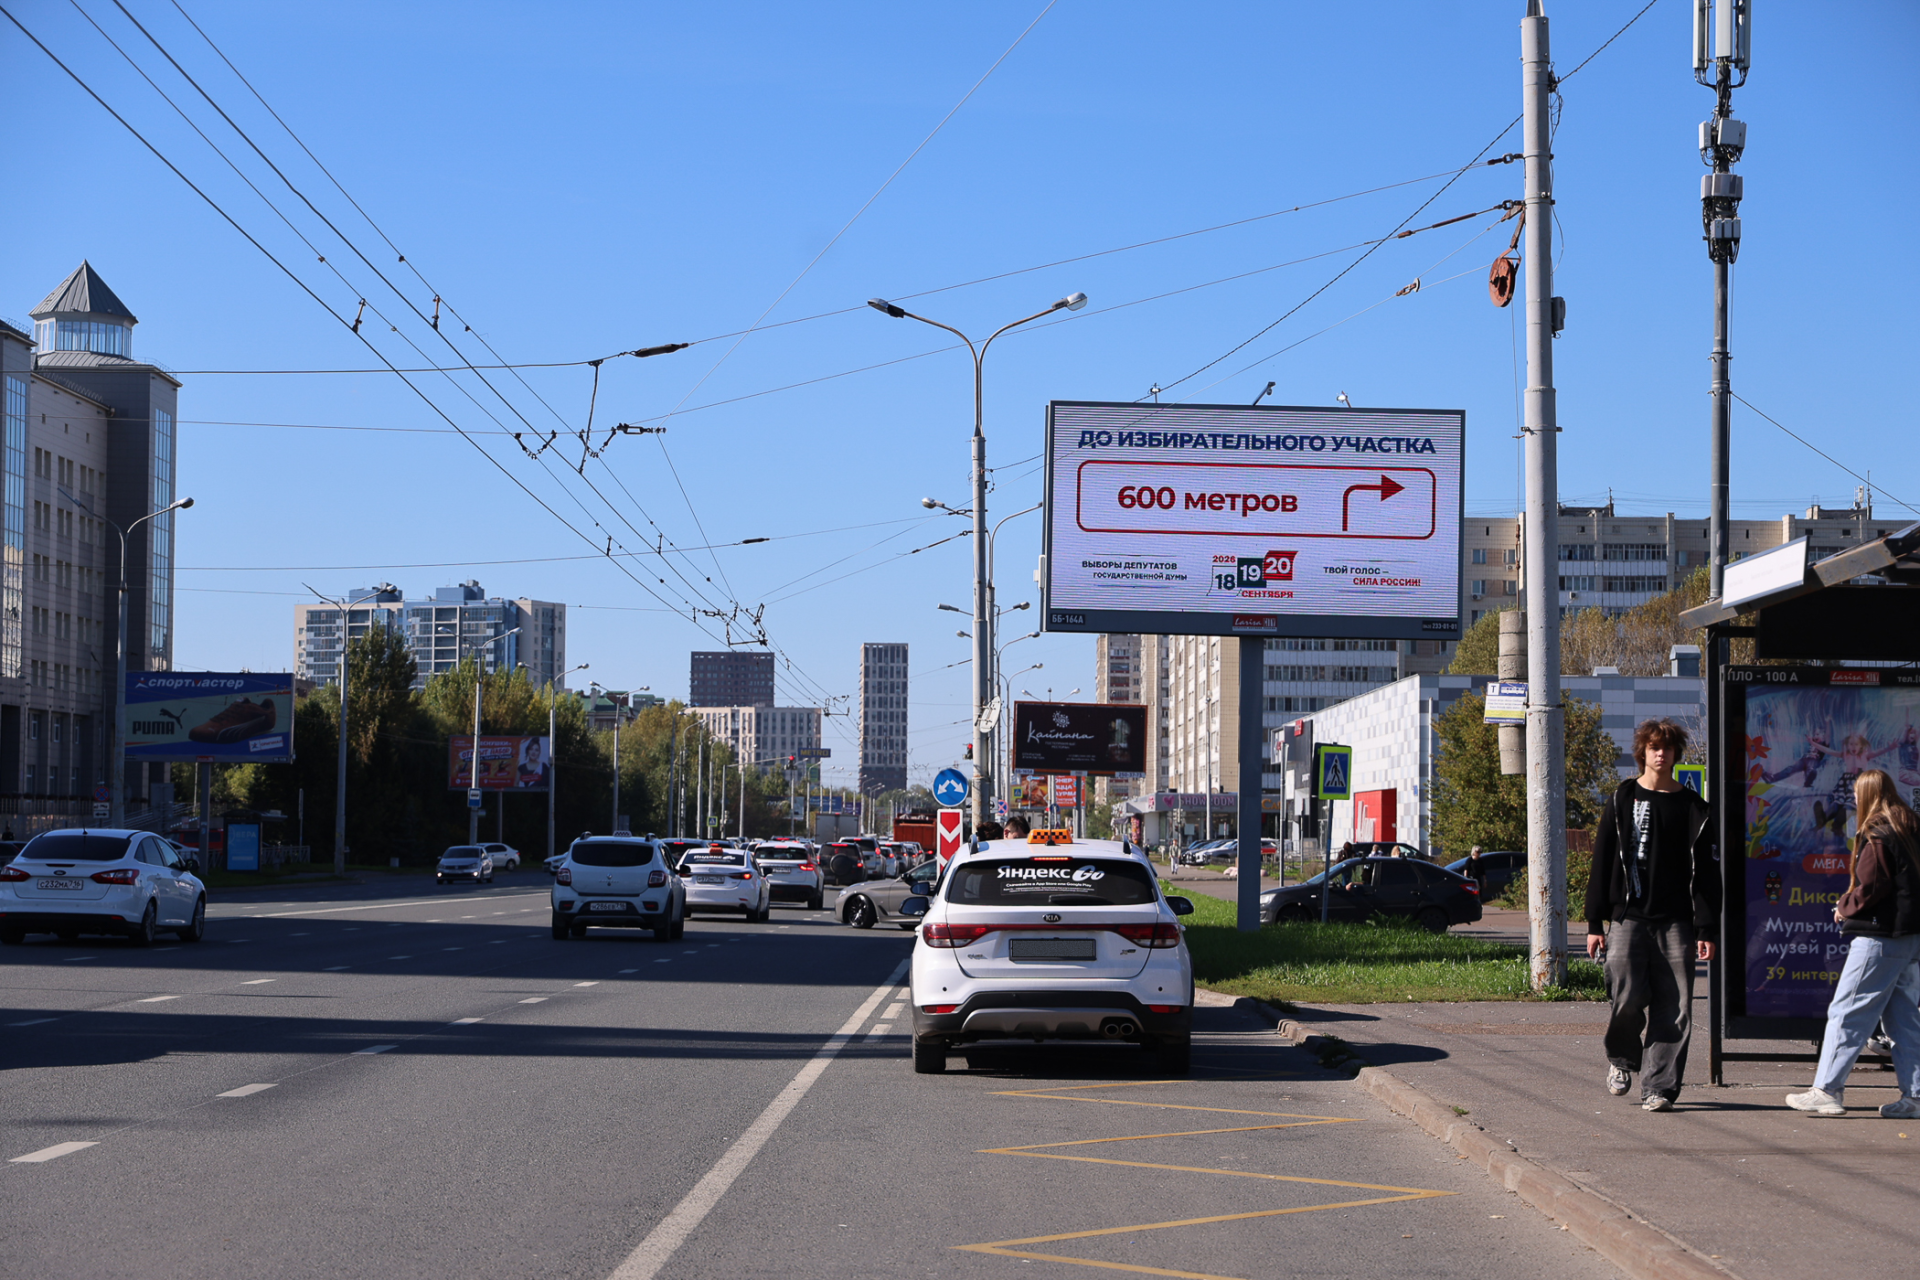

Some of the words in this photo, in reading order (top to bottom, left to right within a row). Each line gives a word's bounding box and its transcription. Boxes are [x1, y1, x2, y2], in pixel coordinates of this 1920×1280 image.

[1078, 430, 1112, 449] ДО
[1118, 431, 1326, 451] ИЗБИРАТЕЛЬНОГО
[1331, 436, 1437, 454] УЧАСТКА
[1118, 486, 1176, 509] 600
[1185, 493, 1298, 517] метров
[1082, 560, 1122, 569] ВЫБОРЫ
[1124, 561, 1178, 570] ДЕПУТАТОВ
[1212, 555, 1236, 563] 2026
[1093, 571, 1164, 580] ГОСУДАРСТВЕННОЙ
[1165, 573, 1187, 581] ДУМЫ
[1214, 573, 1236, 591] 18
[1239, 564, 1261, 582] 19
[1264, 556, 1292, 575] 20
[1323, 565, 1348, 574] ТВОЙ
[1350, 566, 1381, 575] ГОЛОС
[1353, 577, 1379, 586] СИЛА
[1380, 578, 1421, 587] РОССИИ!
[1241, 589, 1294, 599] СЕНТЯБРЯ
[1052, 614, 1084, 624] ББ-164А
[1235, 617, 1262, 626] Larisa
[1727, 670, 1753, 681] ПЛО
[1765, 671, 1786, 682] 100
[1789, 671, 1799, 682] А
[1831, 671, 1863, 681] Larisa
[148, 678, 244, 690] спортмастер
[133, 721, 174, 735] PUMA
[1180, 796, 1235, 806] SHOWOOM
[1812, 858, 1846, 870] МЕГА
[997, 865, 1071, 880] Яндекс
[1072, 865, 1105, 882] Go
[1788, 887, 1840, 906] Дика
[1765, 939, 1819, 960] музей
[1826, 943, 1850, 960] ра
[1766, 966, 1786, 980] 39
[1791, 970, 1839, 985] интер
